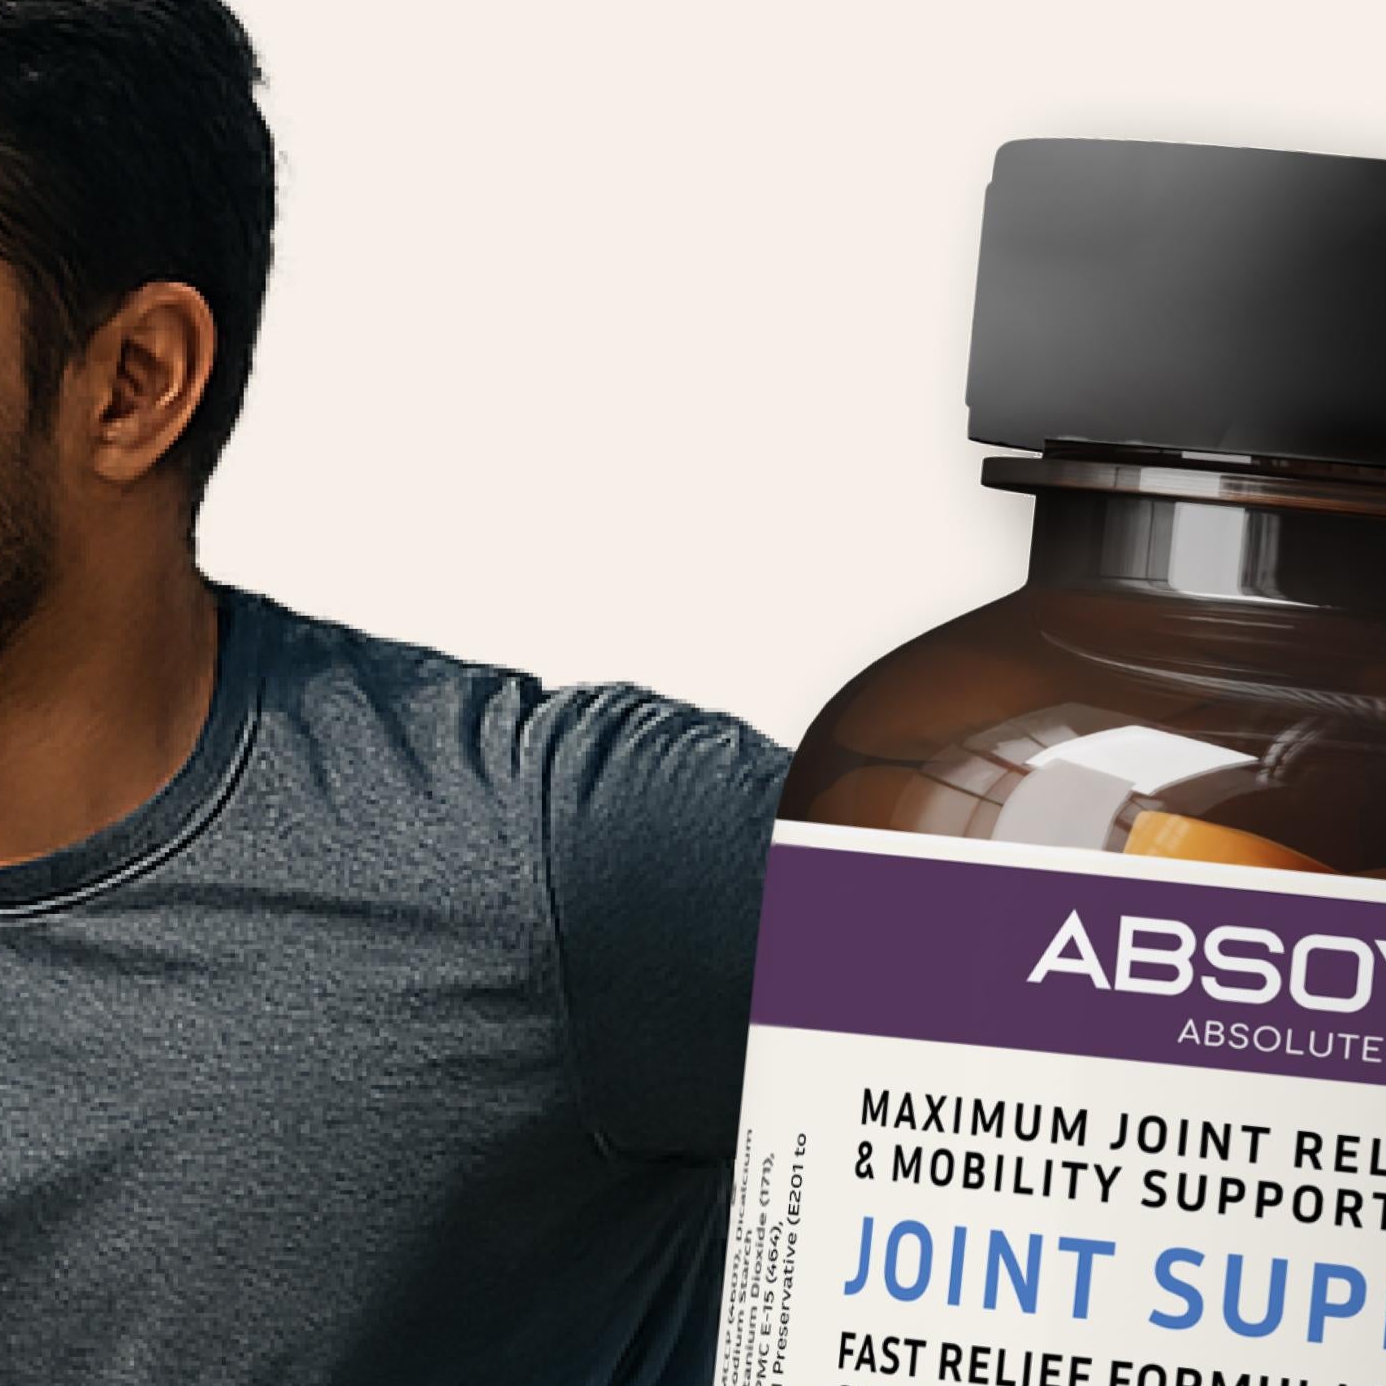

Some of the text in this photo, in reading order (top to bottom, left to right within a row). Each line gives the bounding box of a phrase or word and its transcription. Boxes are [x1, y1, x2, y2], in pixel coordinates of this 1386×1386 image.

[1178, 1019, 1383, 1063] ABSOLUTE
[793, 1132, 807, 1158] to
[861, 1088, 1087, 1146] MAXIMUM
[1110, 1113, 1271, 1164] JOINT
[786, 1164, 804, 1227] (E201
[855, 1141, 874, 1179] &
[892, 1144, 1122, 1203] MOBILITY
[737, 1229, 753, 1304] Starch
[751, 1212, 767, 1299] Dioxide
[765, 1220, 784, 1285] (464),
[845, 1218, 1115, 1318] JOINT
[761, 1290, 775, 1337] E-15
[771, 1231, 798, 1375] Preservative
[838, 1331, 927, 1377] FAST
